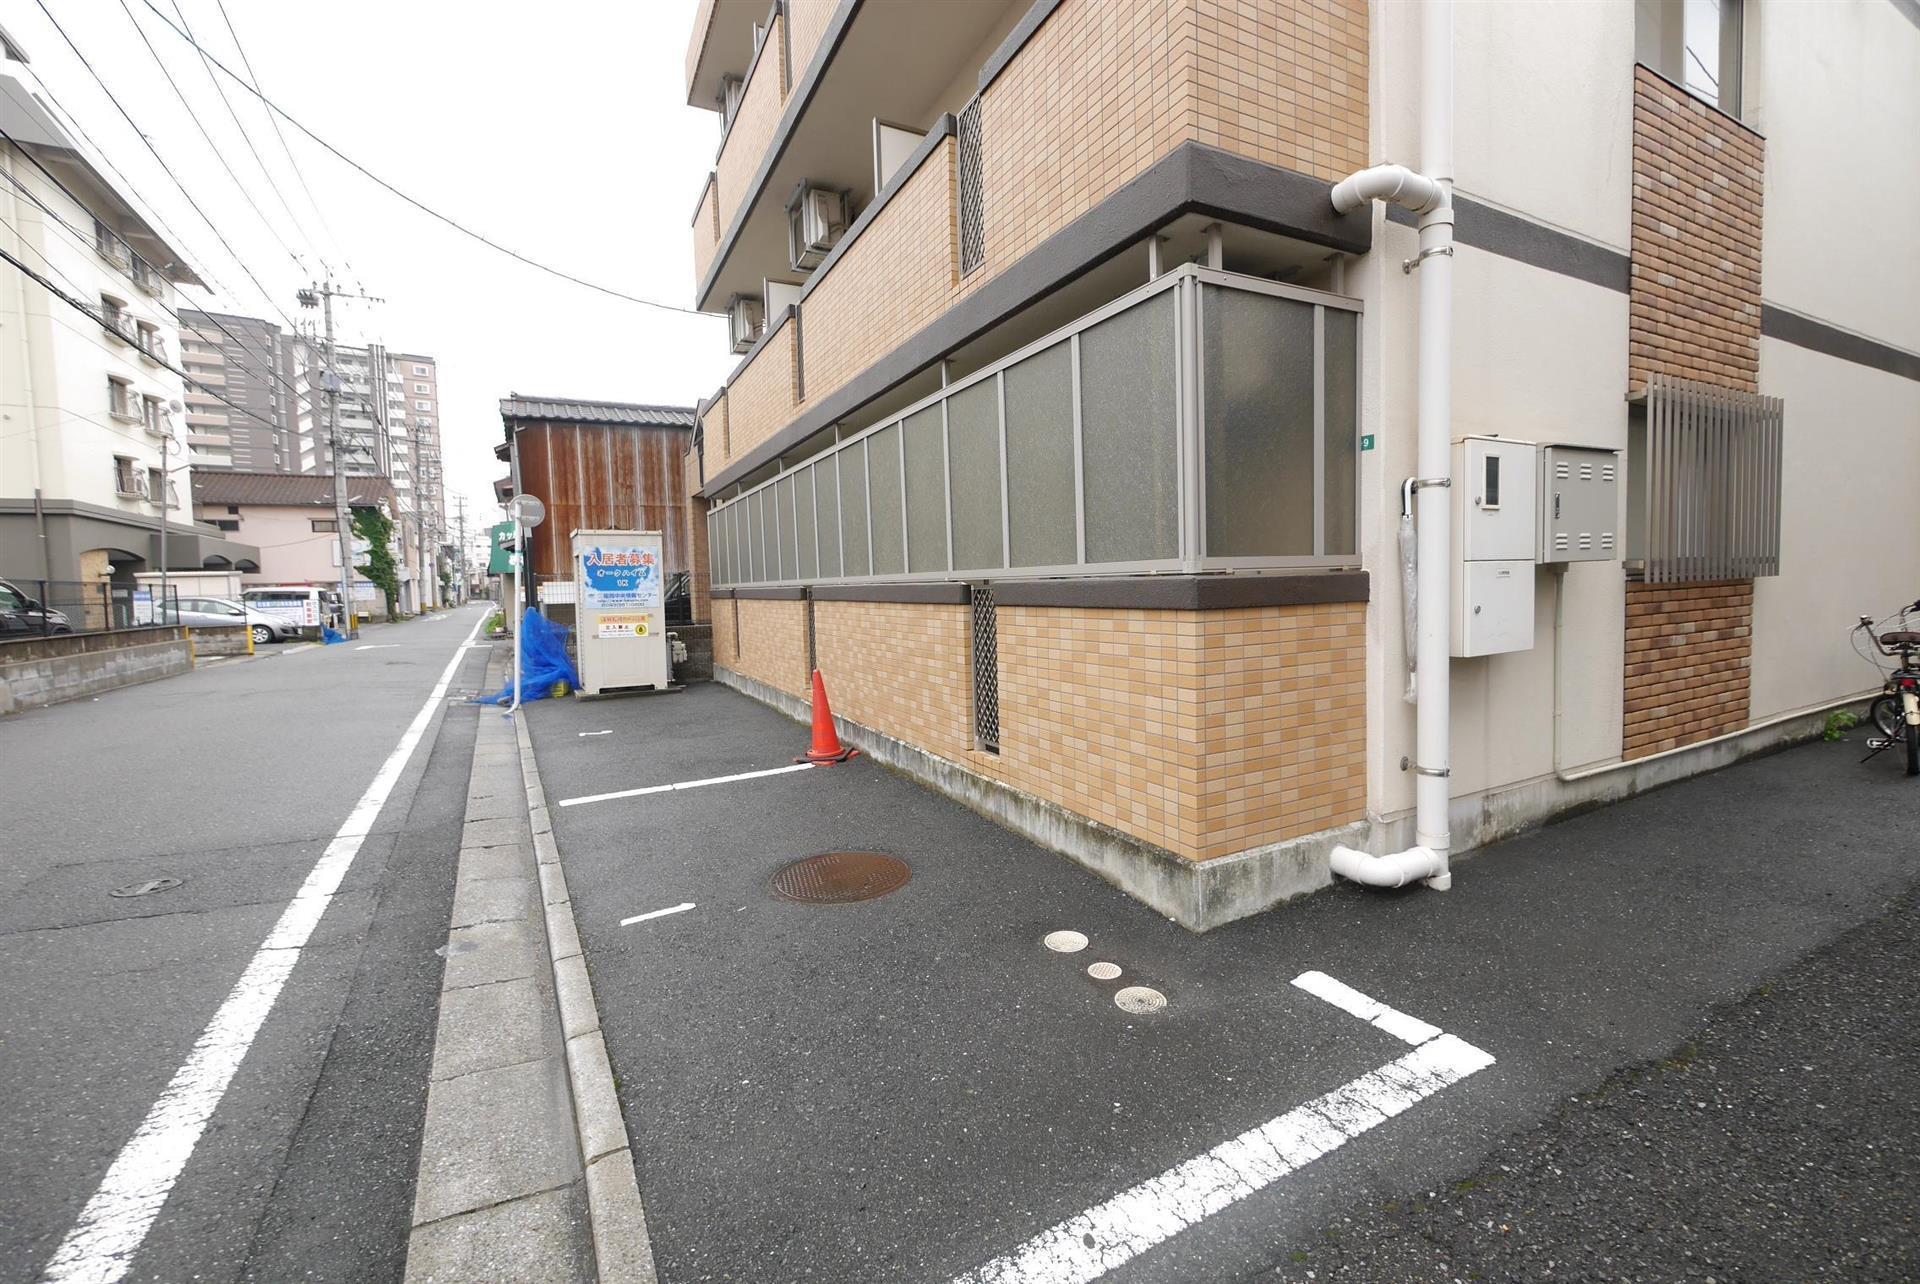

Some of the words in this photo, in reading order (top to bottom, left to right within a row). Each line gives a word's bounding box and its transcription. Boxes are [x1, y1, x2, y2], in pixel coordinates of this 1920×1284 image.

[588, 553, 656, 566] 入居者募集
[597, 569, 647, 577] オークハイム
